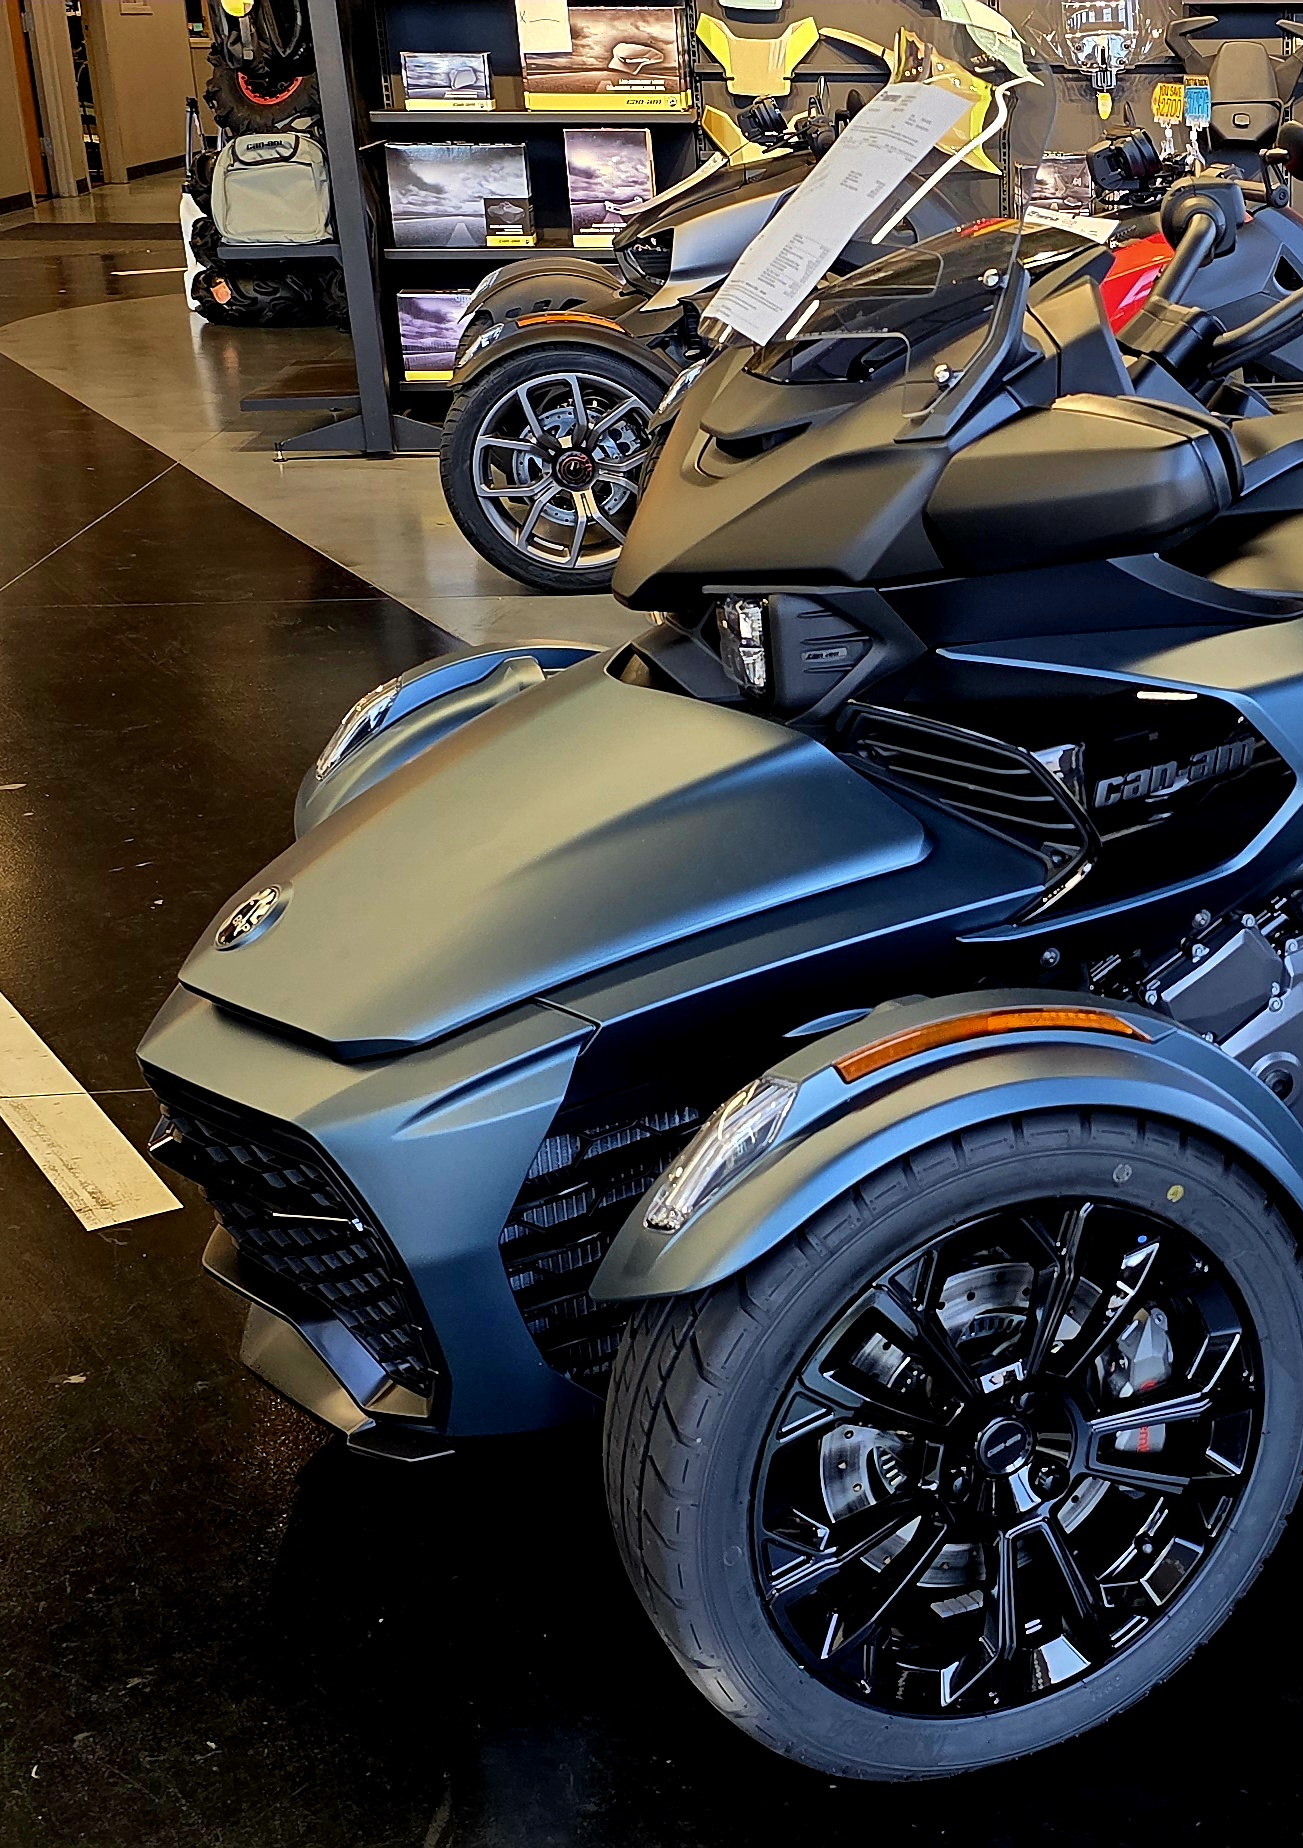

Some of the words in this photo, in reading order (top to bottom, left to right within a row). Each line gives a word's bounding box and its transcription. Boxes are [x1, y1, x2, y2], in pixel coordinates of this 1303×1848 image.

[1159, 84, 1169, 97] YOU
[1170, 86, 1182, 97] SAVE
[1094, 737, 1256, 808] can-am
